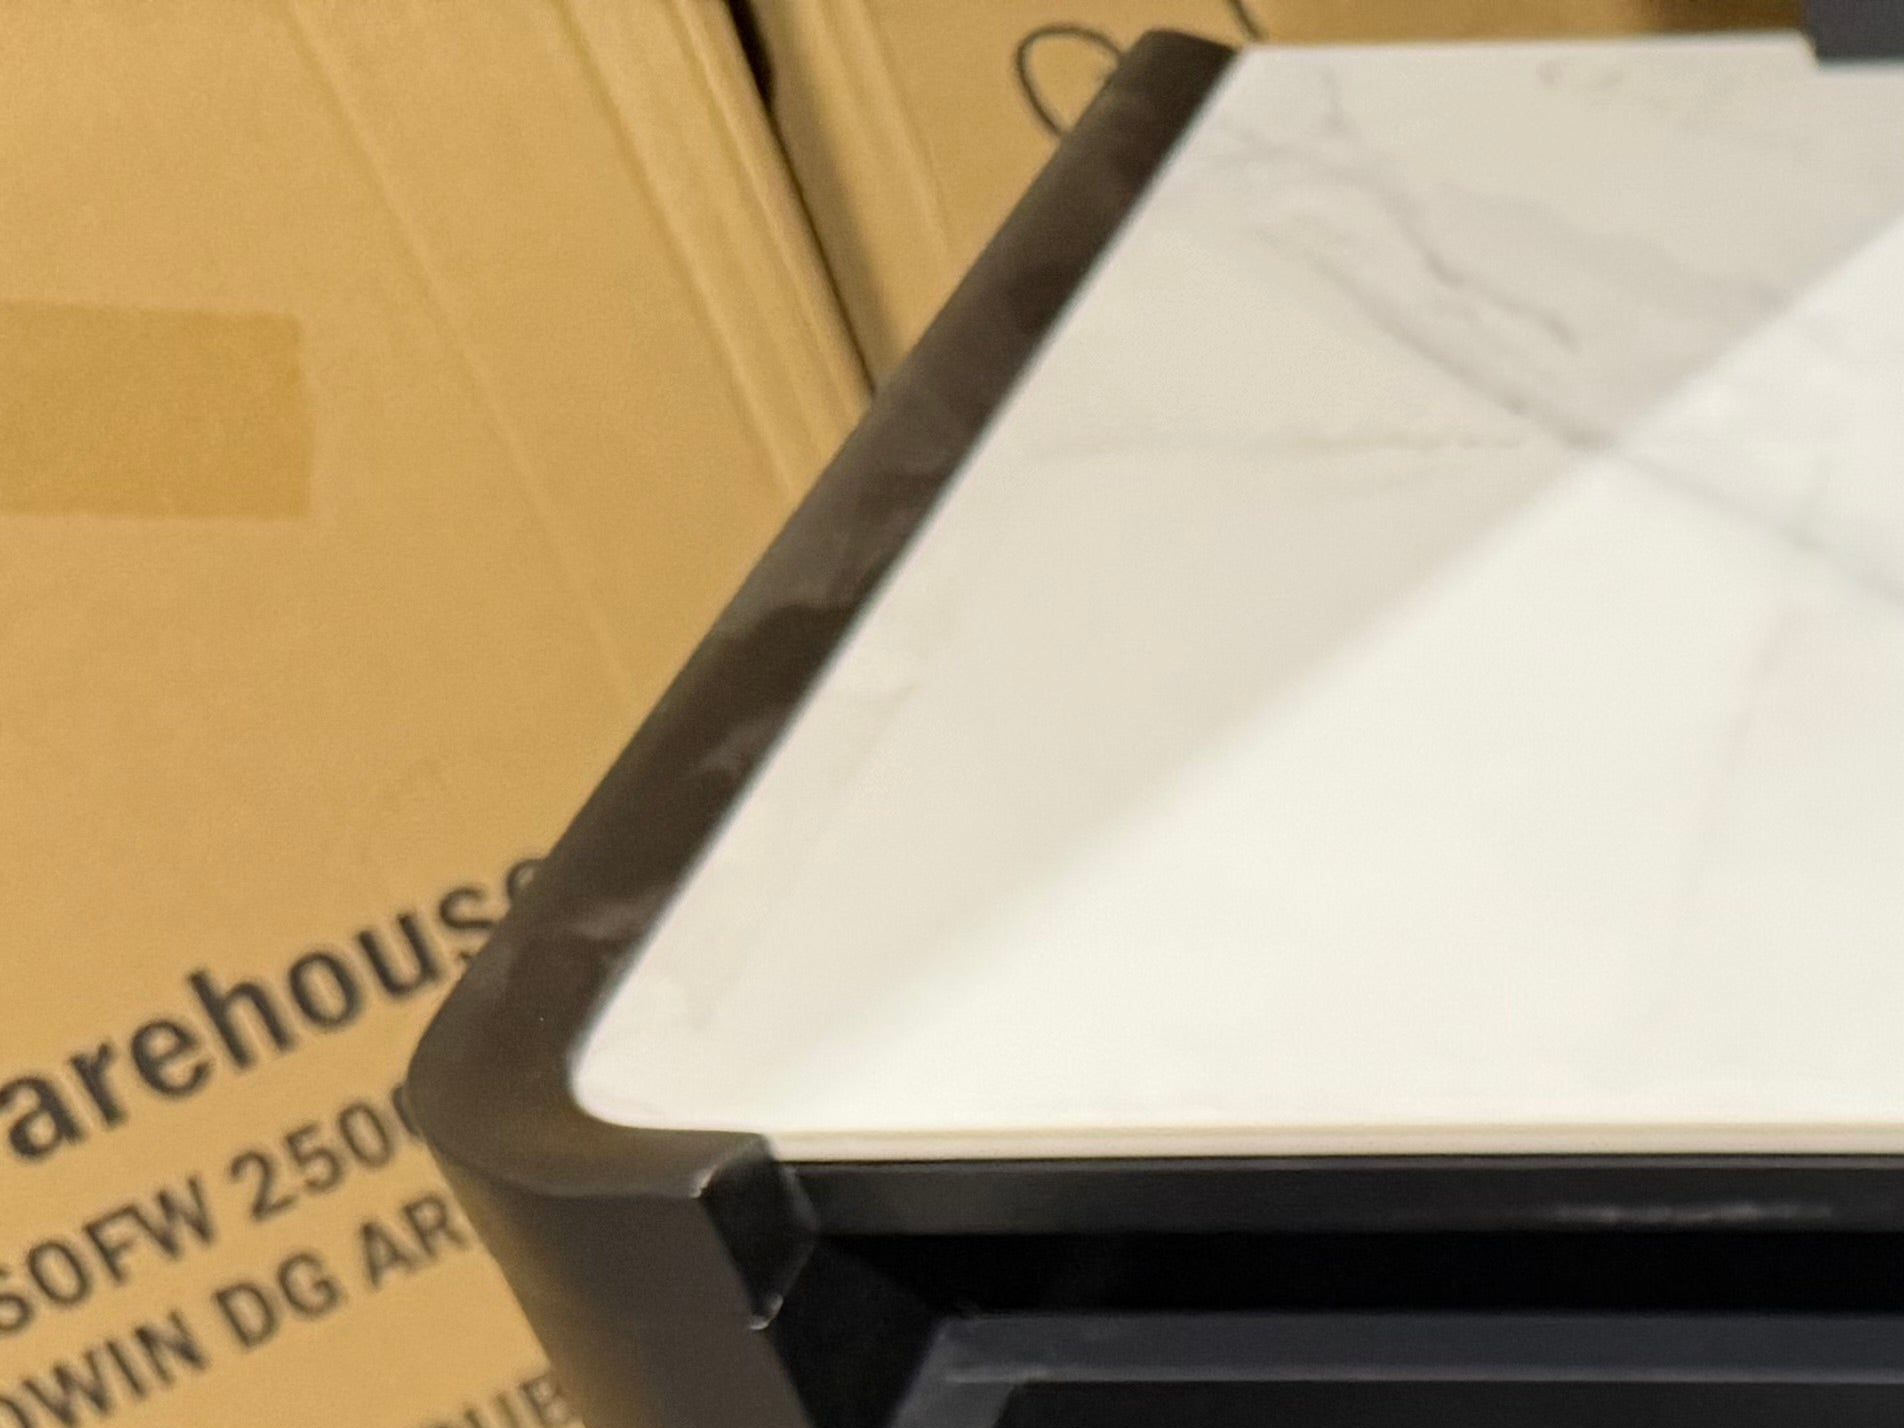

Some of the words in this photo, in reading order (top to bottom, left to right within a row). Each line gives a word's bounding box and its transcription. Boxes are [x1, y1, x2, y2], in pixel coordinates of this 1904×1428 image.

[0, 857, 549, 1164] arehous
[212, 1249, 348, 1350] DG
[360, 1193, 470, 1290] AR
